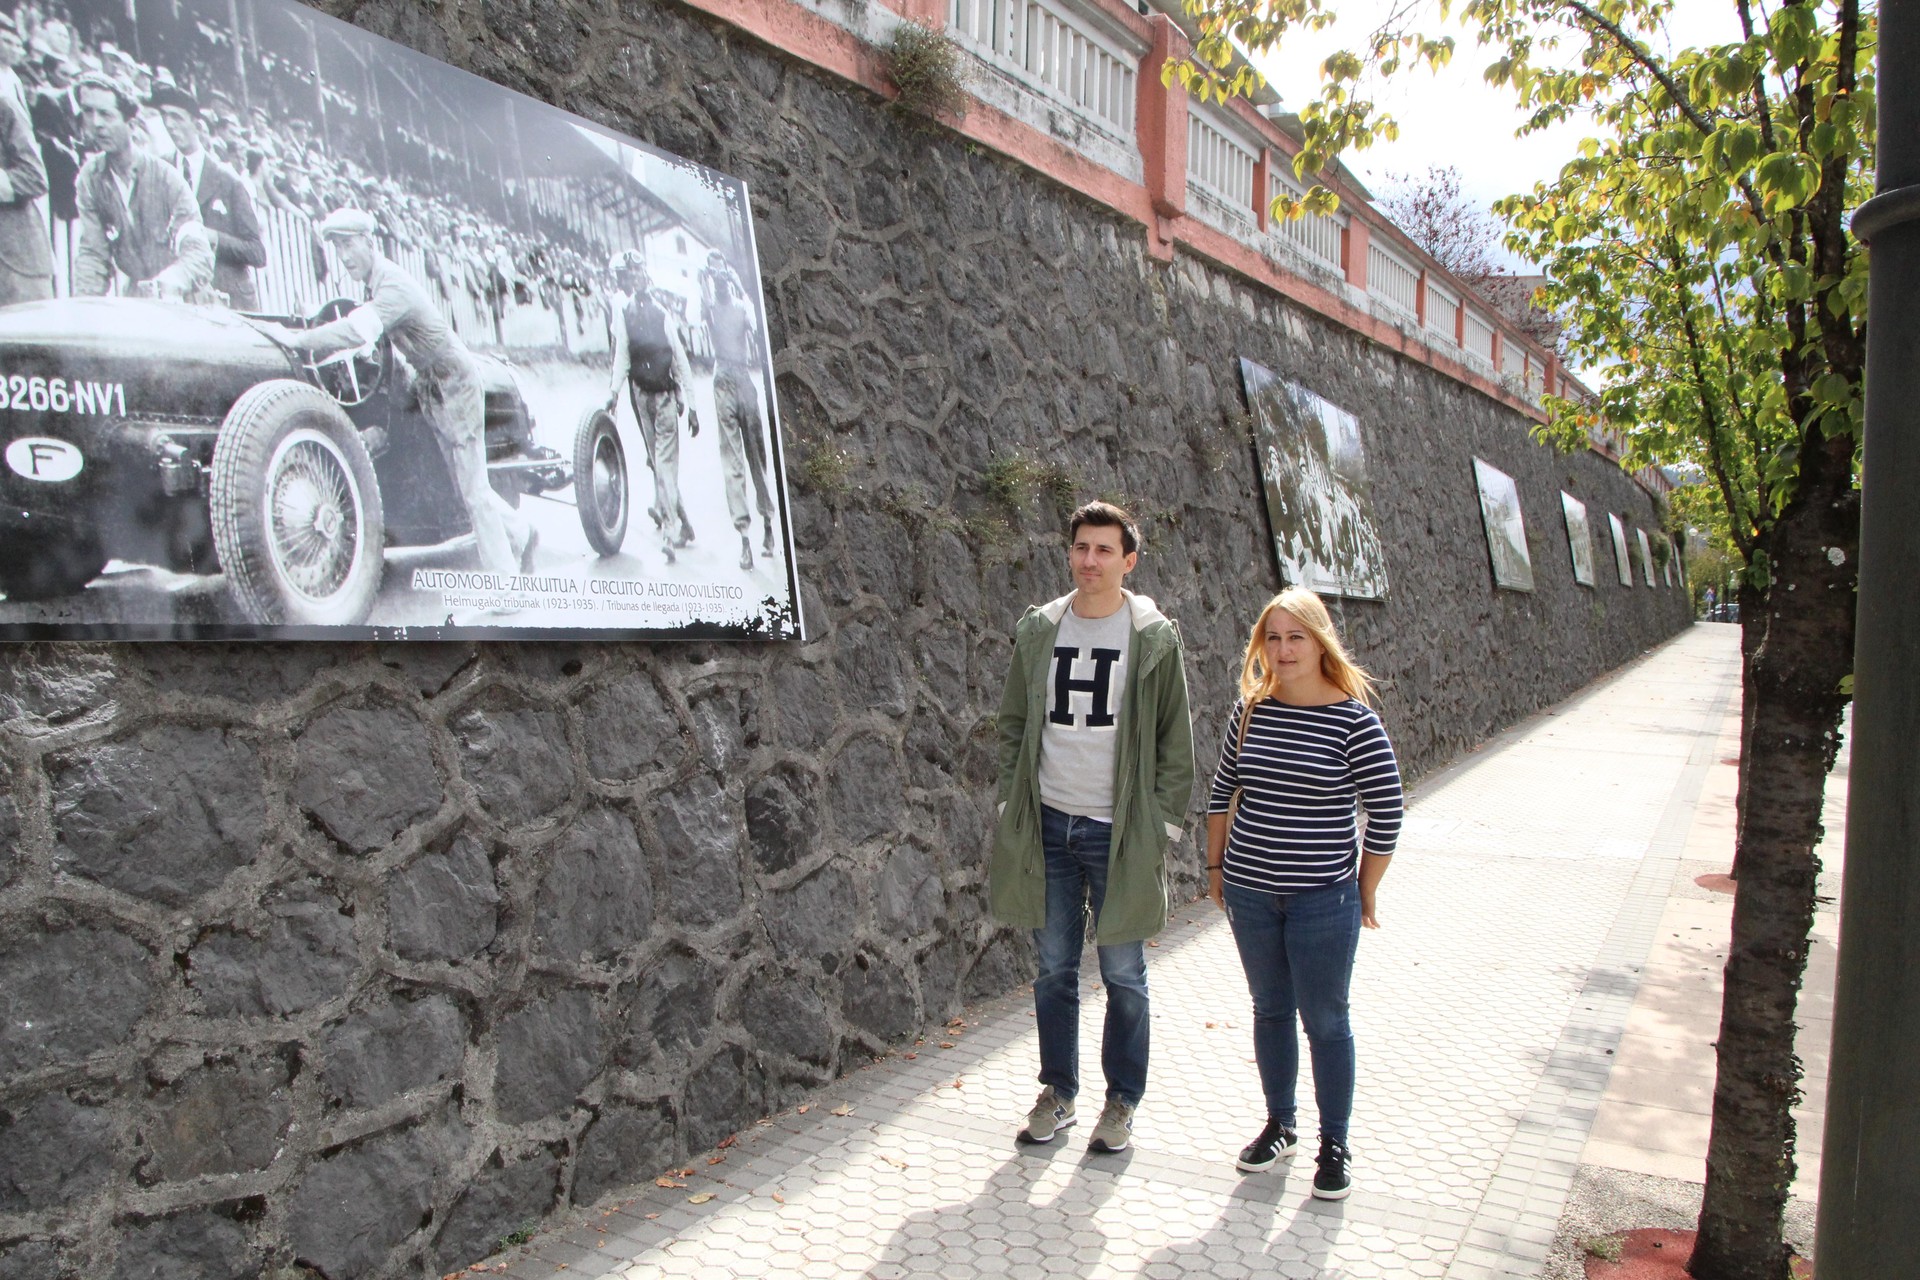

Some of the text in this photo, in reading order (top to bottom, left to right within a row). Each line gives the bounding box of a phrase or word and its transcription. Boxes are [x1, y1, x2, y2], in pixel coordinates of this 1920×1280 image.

[28, 443, 67, 476] F
[414, 571, 578, 594] AUTOMOBIL-ZIRKUITUA
[590, 579, 644, 597] CIRCUITO
[647, 583, 743, 600] AUTOMOVILÍSTICO
[444, 595, 501, 611] Helmugako
[503, 597, 541, 610] tribunak
[542, 598, 599, 612] (1923-1935).
[606, 599, 640, 612] Tribunas
[641, 601, 651, 612] de
[653, 601, 680, 615] llegada
[1050, 646, 1122, 730] H
